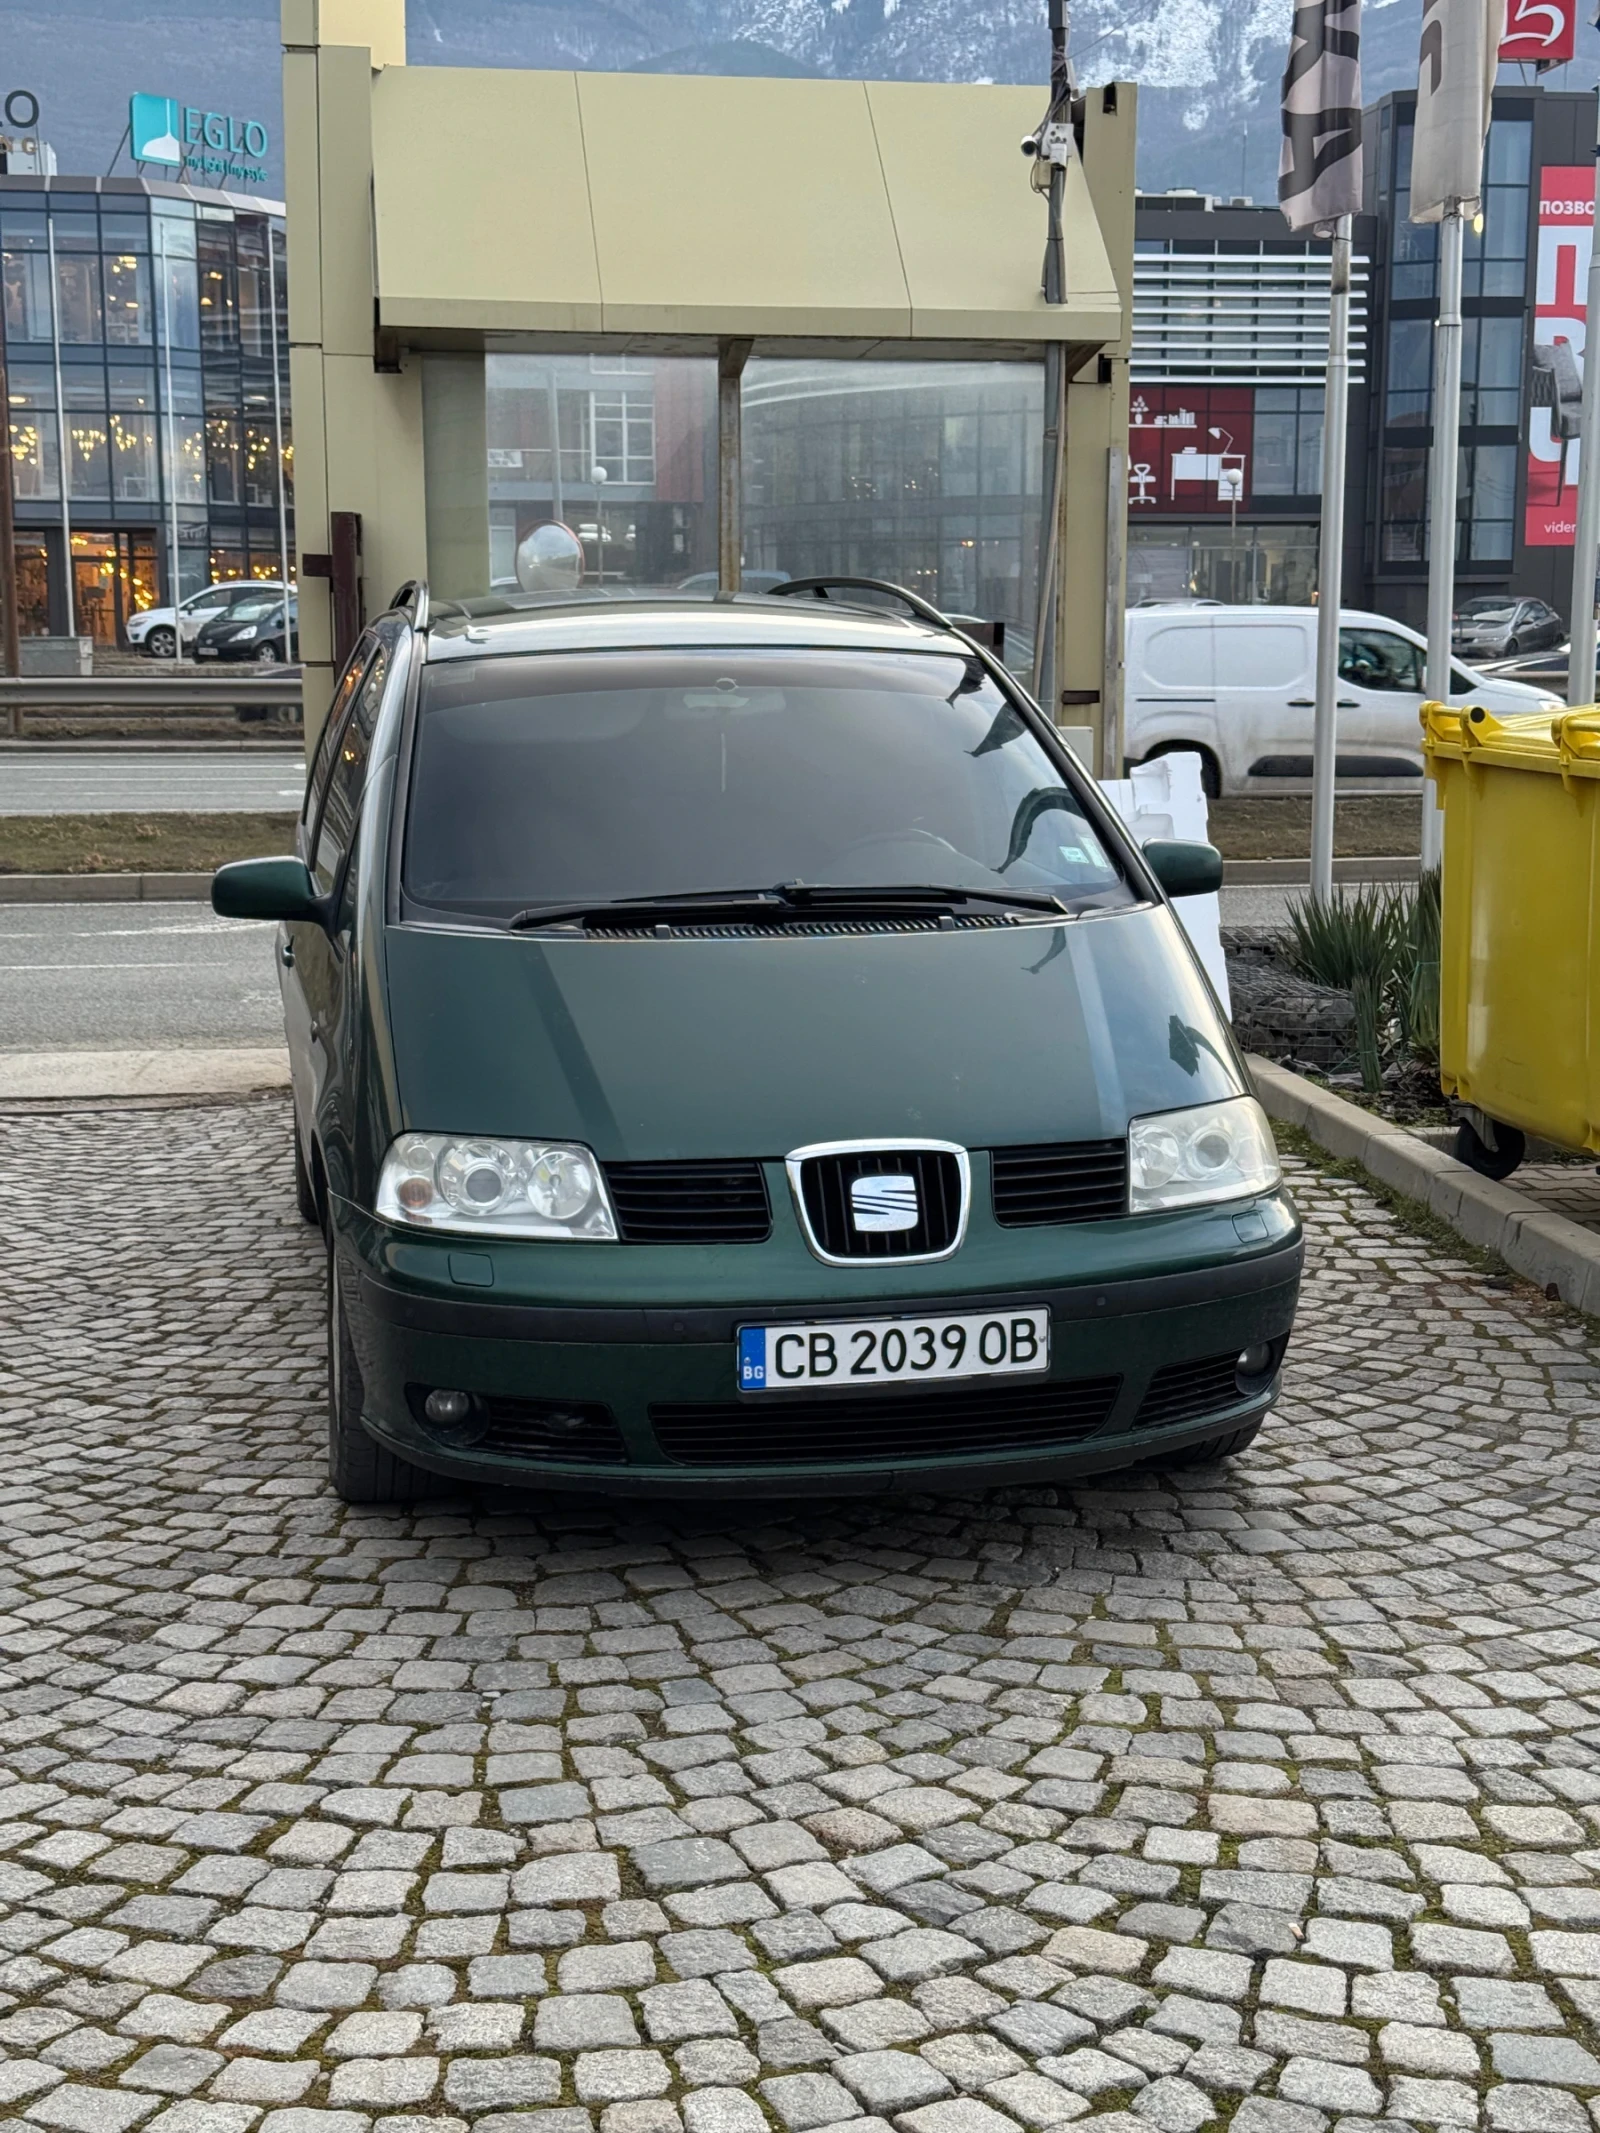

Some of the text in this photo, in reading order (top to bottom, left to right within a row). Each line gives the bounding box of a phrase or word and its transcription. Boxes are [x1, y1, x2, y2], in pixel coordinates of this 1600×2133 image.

[183, 107, 268, 158] EGLO
[743, 1365, 764, 1380] BG
[774, 1318, 1039, 1379] CB 2039 OB
